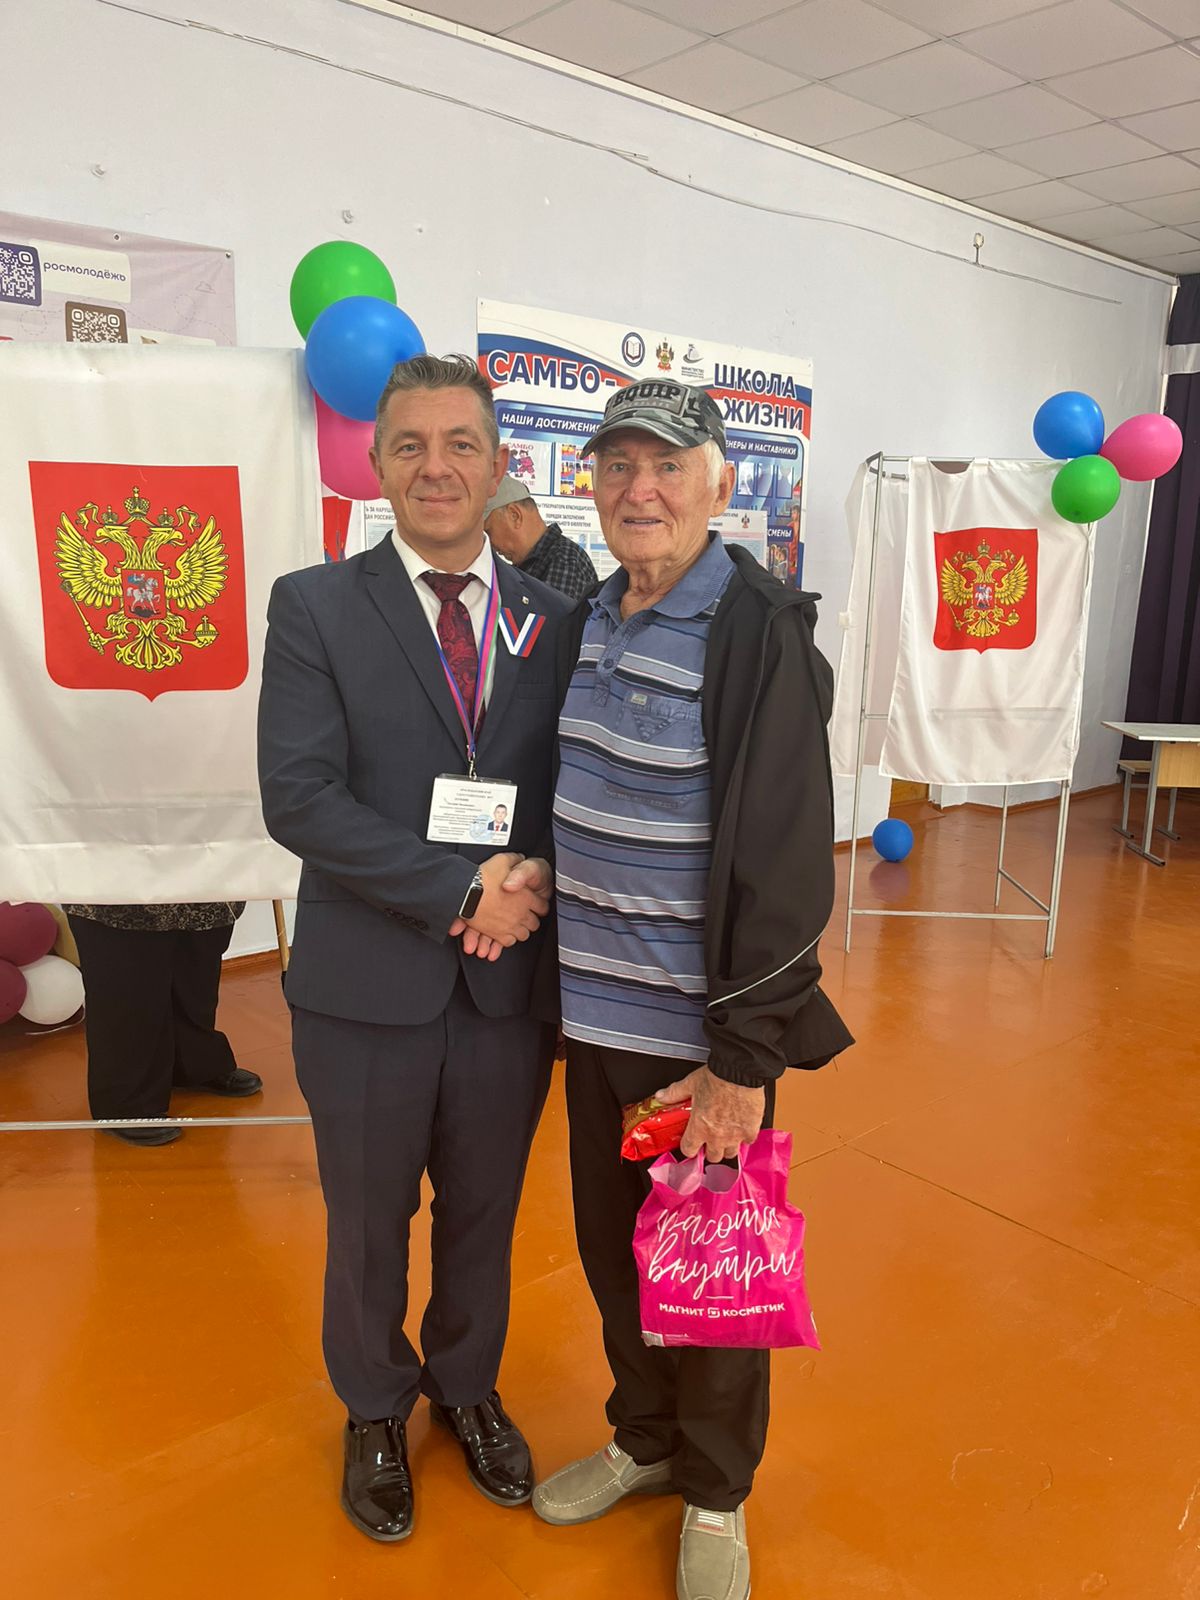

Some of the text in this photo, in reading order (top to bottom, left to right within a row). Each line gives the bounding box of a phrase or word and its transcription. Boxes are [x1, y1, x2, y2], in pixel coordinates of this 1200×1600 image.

[43, 261, 127, 282] росмолодёжь
[715, 363, 796, 398] ШКОЛА
[502, 413, 534, 426] НАШИ
[723, 398, 803, 431] ЖИЗНИ
[726, 439, 797, 455] ЕНЕРЫ И НАСТАВНИКИ
[658, 1303, 786, 1317] МАГНИТ КОСМЕТИК
